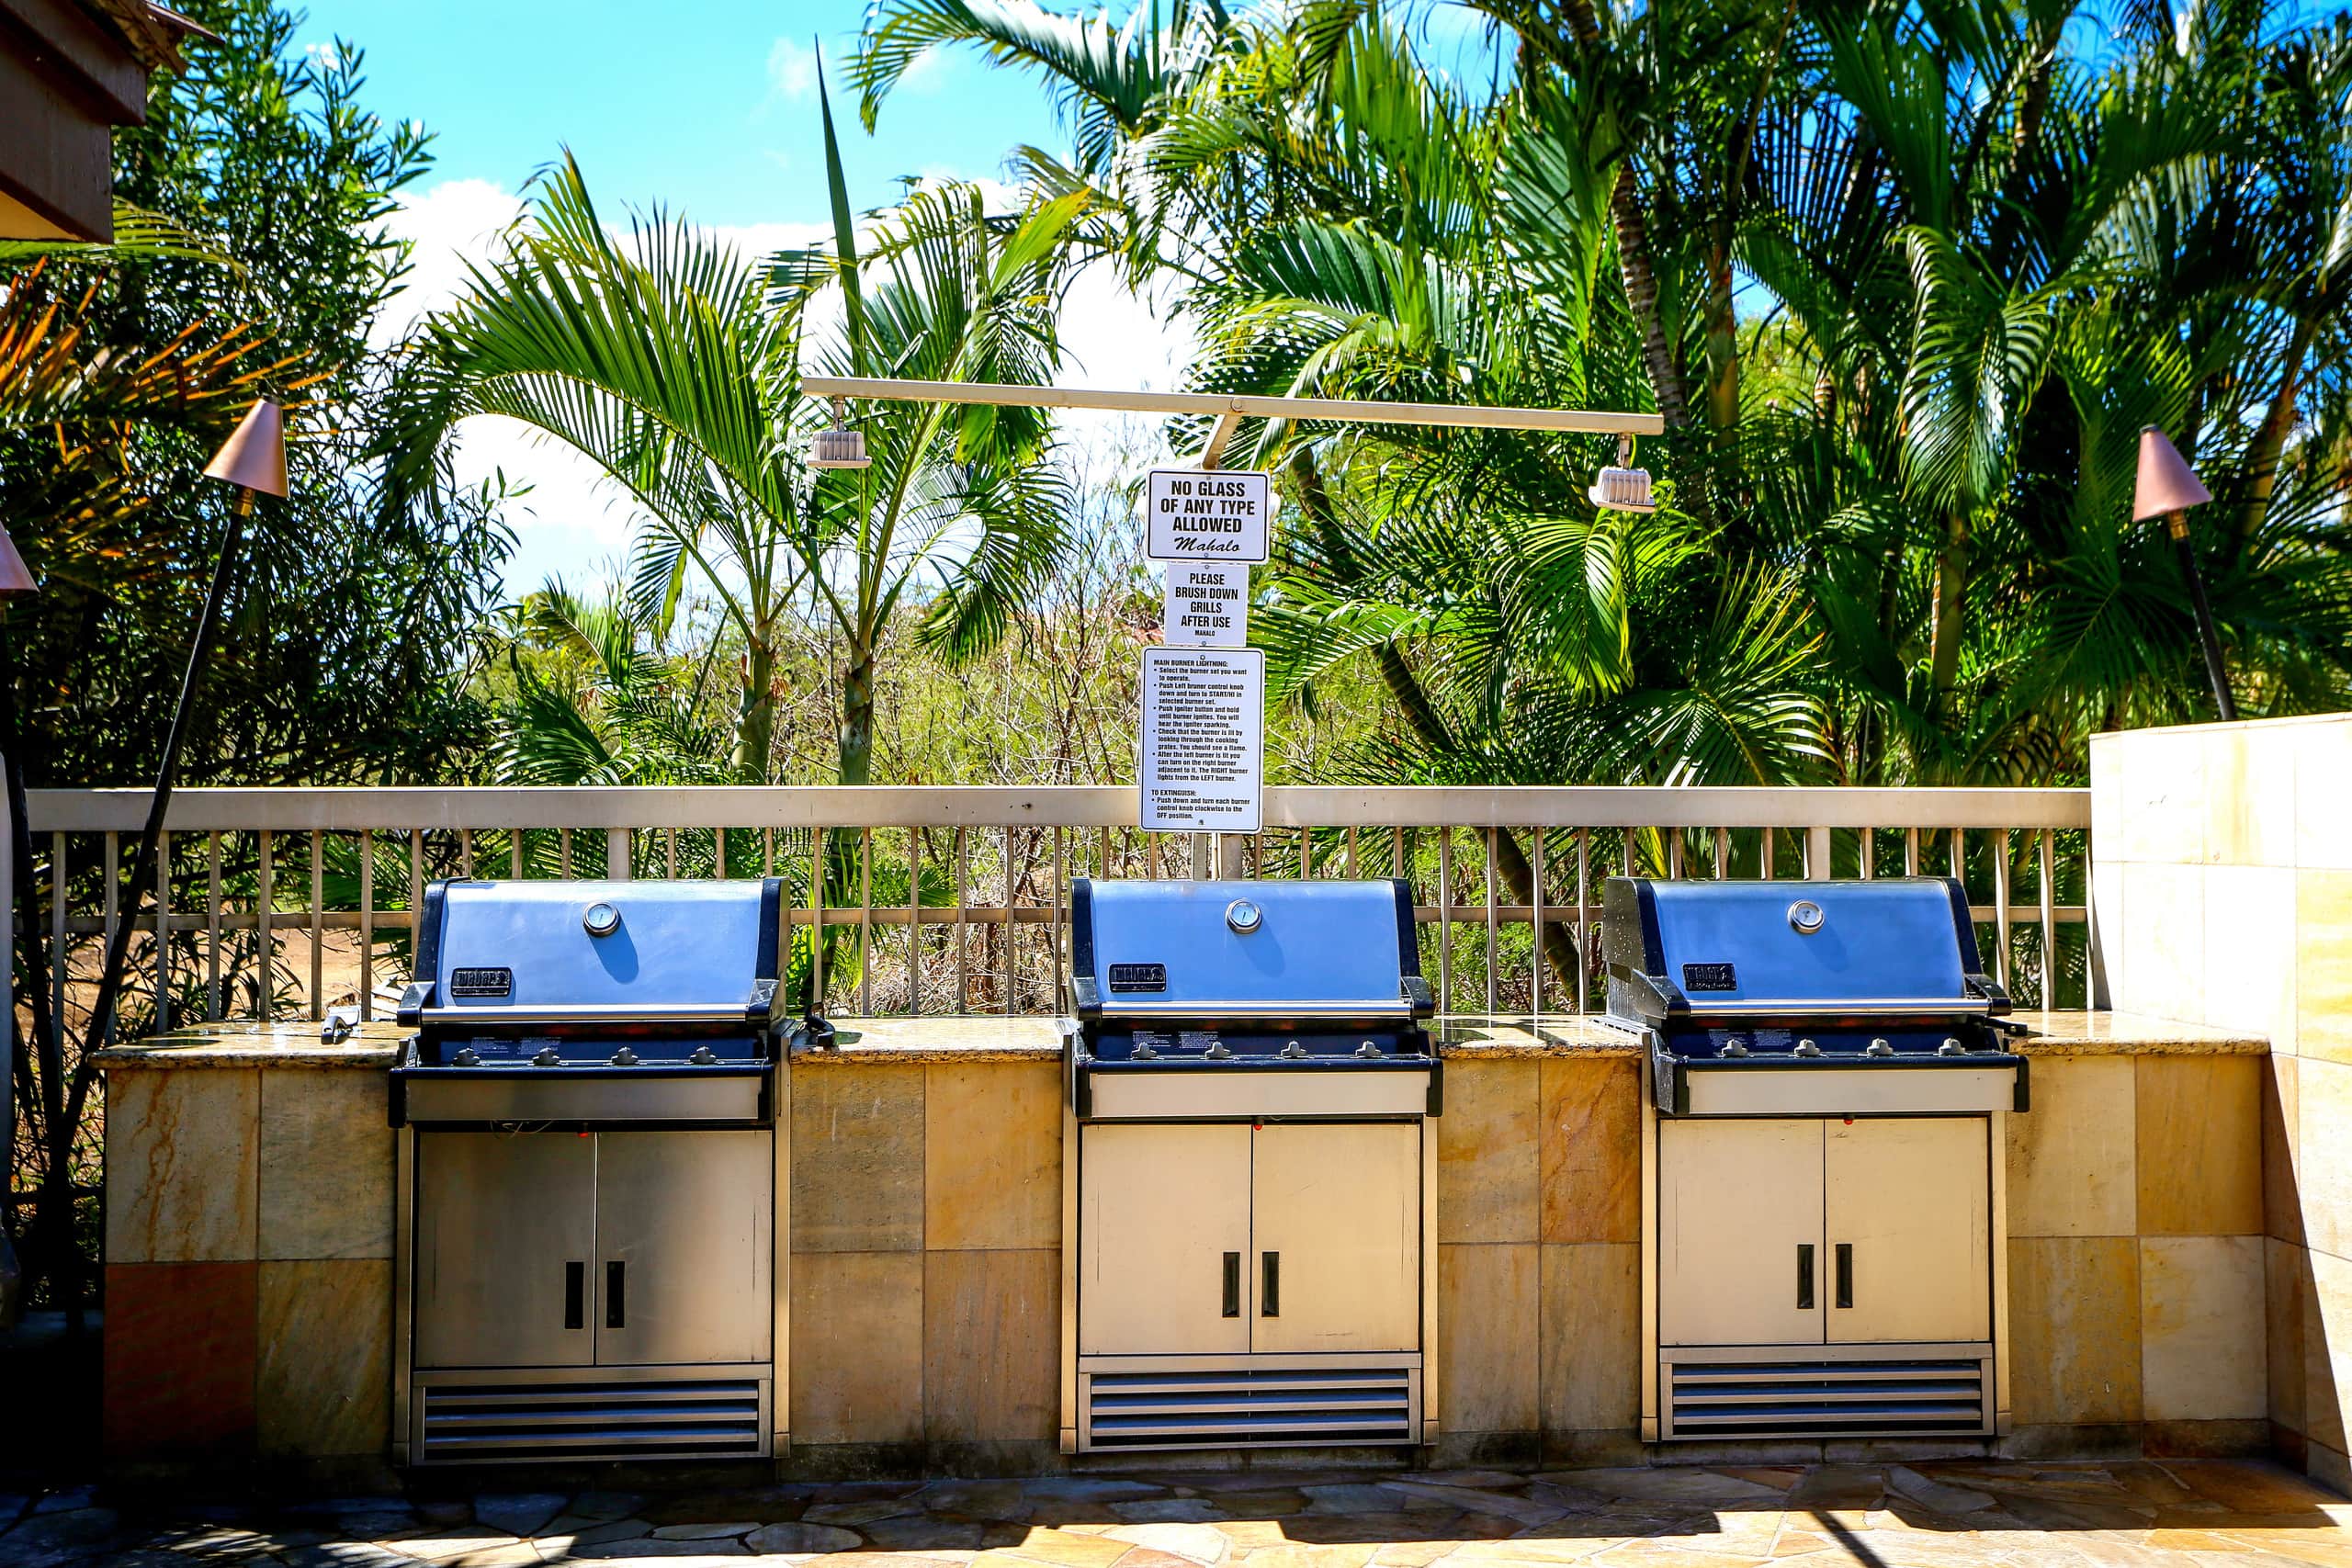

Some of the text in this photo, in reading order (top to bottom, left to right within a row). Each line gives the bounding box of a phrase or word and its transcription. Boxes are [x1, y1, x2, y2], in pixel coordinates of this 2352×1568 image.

[1172, 481, 1245, 497] NO GLASS
[1161, 499, 1255, 515] OF ANY TYPE
[1172, 517, 1242, 532] ALLOWED
[1174, 536, 1240, 552] Mahalo
[1190, 573, 1225, 585] PLEASE
[1176, 587, 1238, 599] BRUSH DOWN
[1190, 602, 1222, 613] GRILLS
[1181, 616, 1230, 628] AFTER USE
